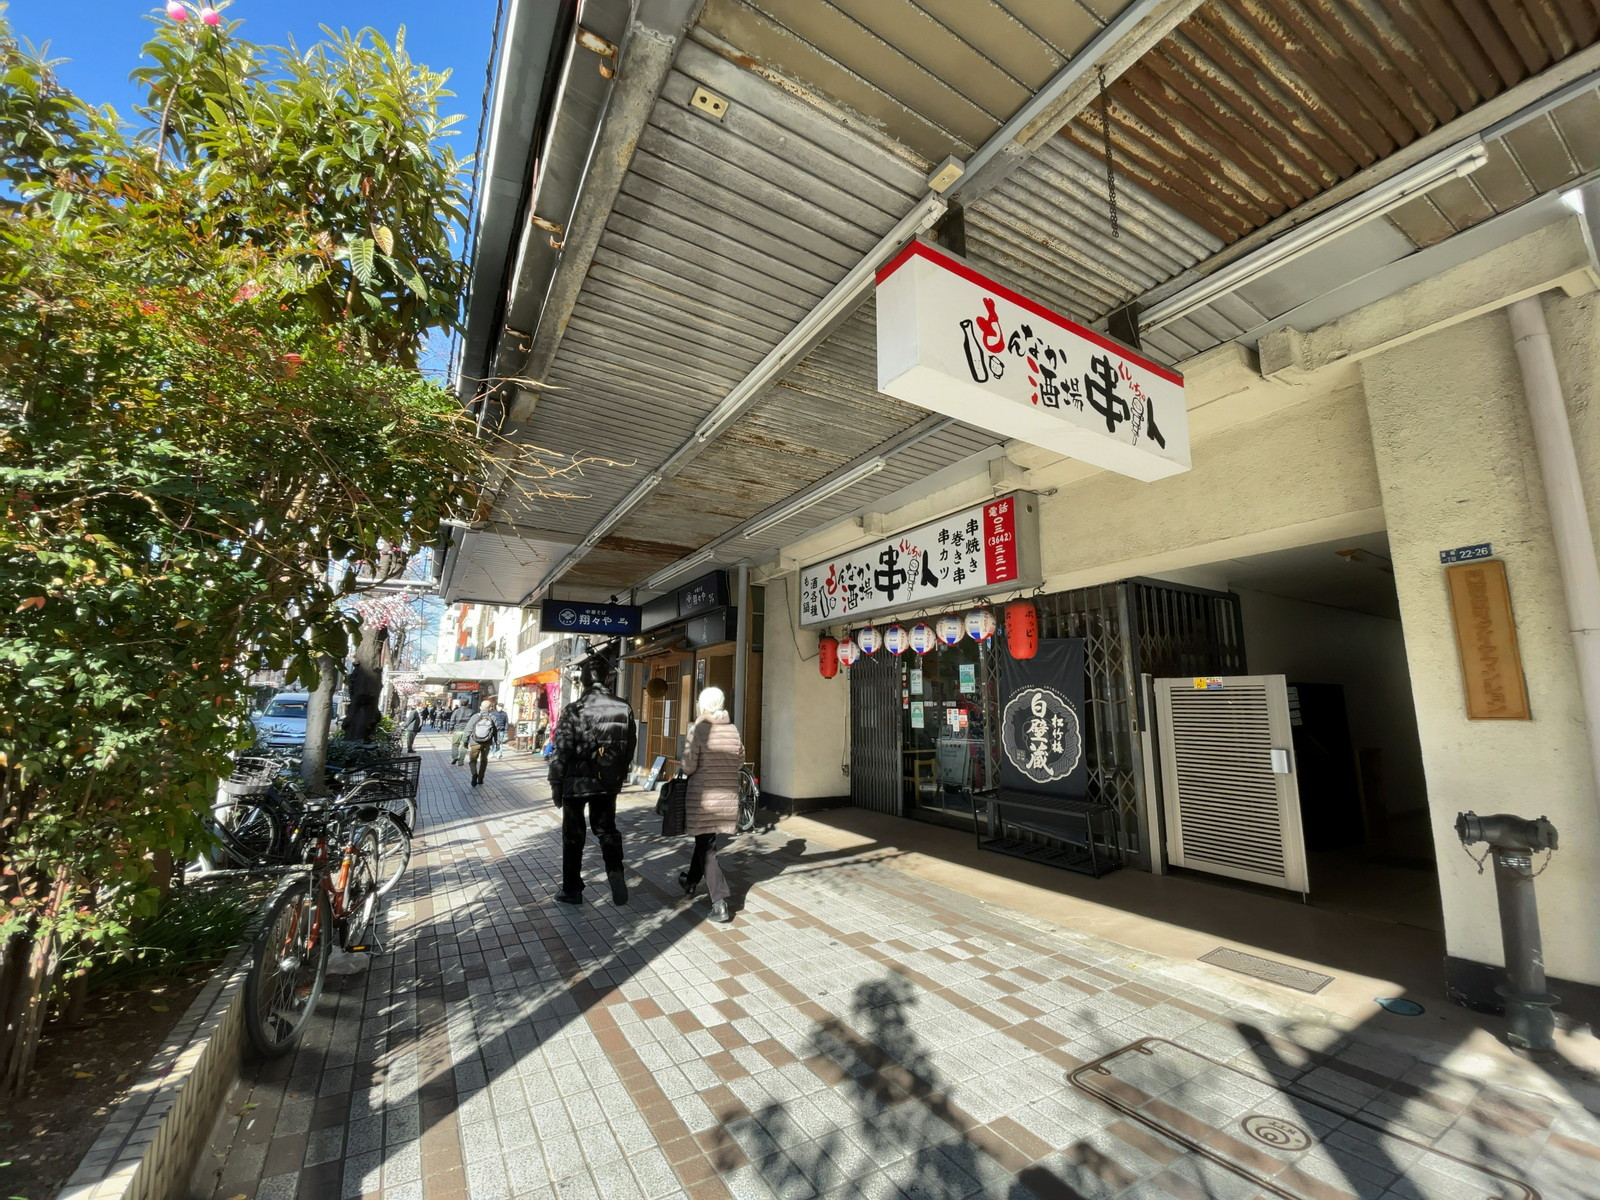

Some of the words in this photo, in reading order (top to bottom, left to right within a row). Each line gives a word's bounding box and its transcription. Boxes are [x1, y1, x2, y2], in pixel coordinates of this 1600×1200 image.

[1026, 356, 1084, 412] 酒場
[988, 502, 1008, 517] 電話
[938, 528, 950, 580] 串カツ
[951, 530, 966, 585] 巻き串
[965, 518, 980, 573] 串焼き
[988, 532, 1012, 547] (3642)
[1460, 547, 1489, 559] 22-26
[842, 578, 873, 613] 酒場
[579, 614, 612, 626] 翔々や
[1026, 692, 1054, 776] 白壁蔵
[1051, 713, 1064, 754] 松竹梅
